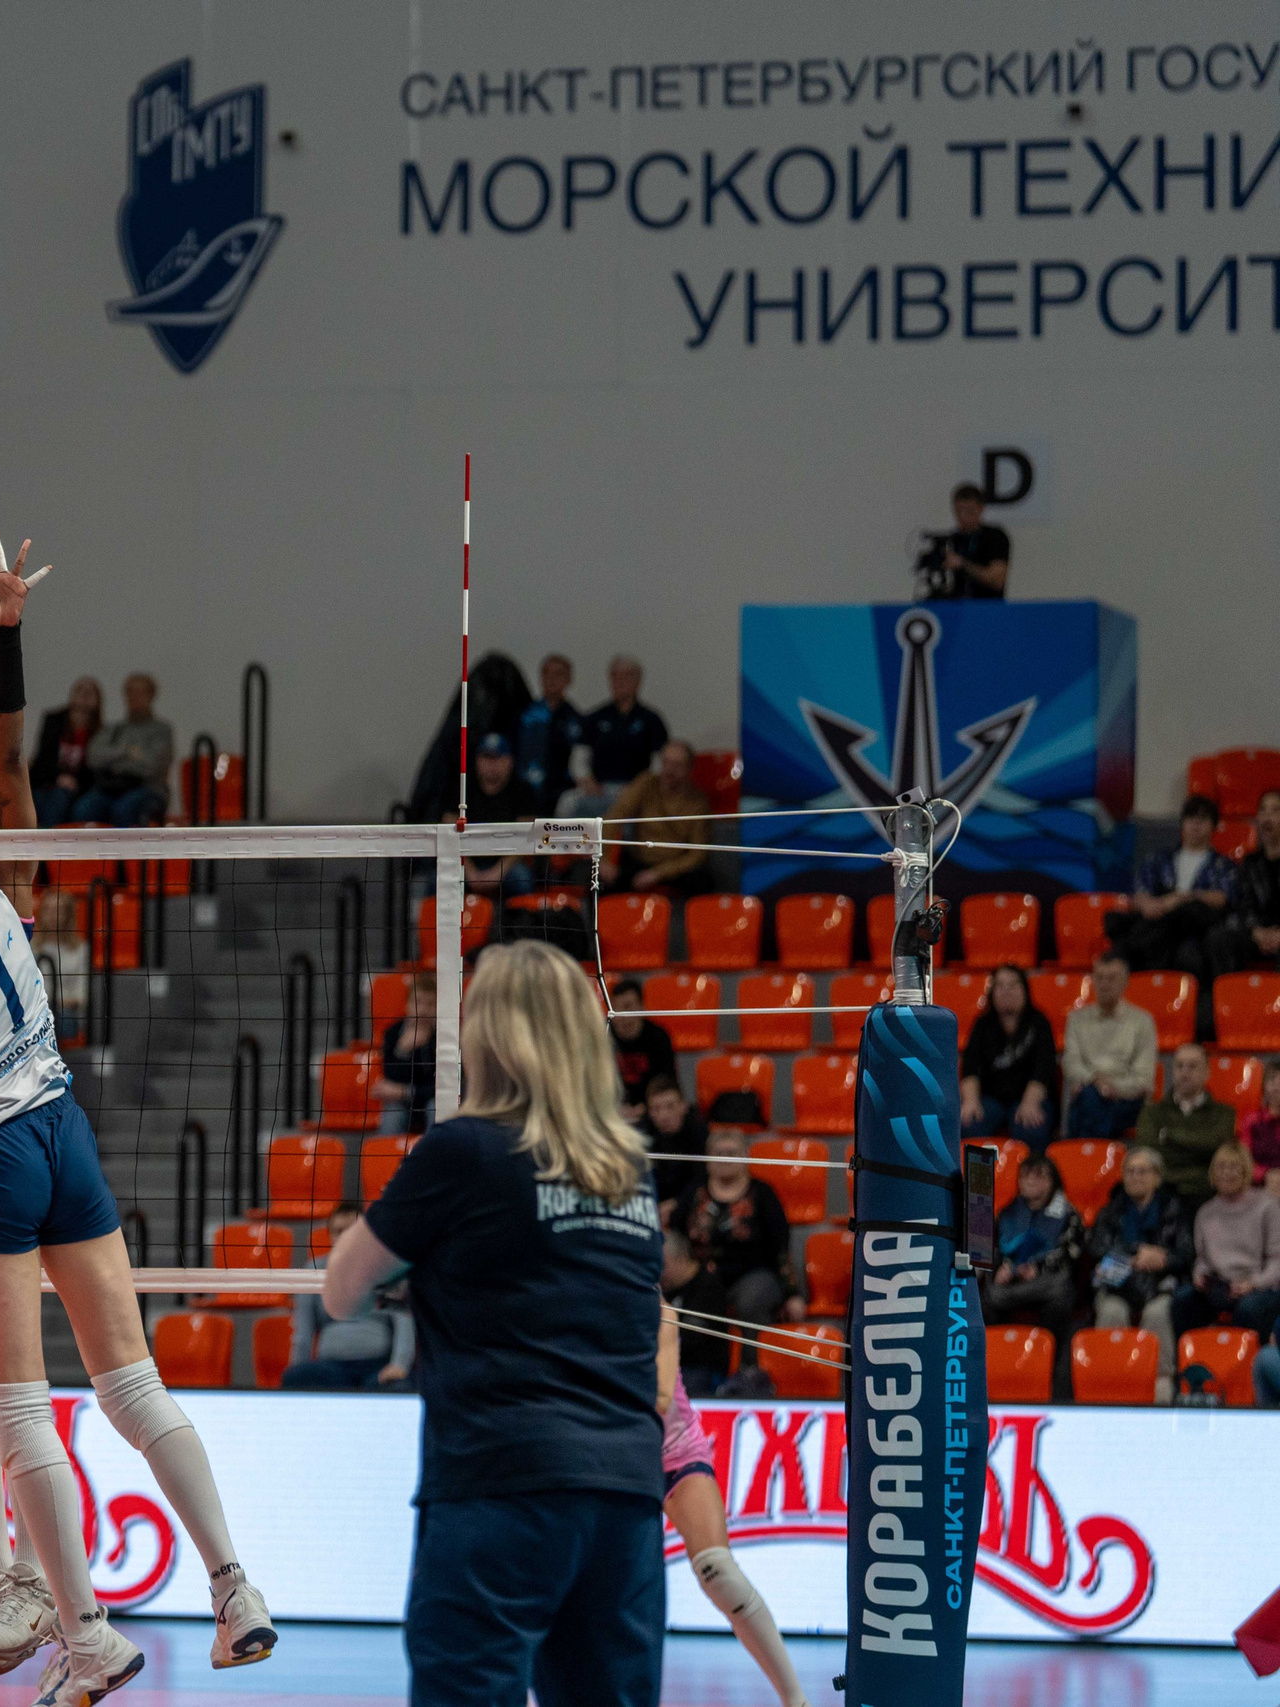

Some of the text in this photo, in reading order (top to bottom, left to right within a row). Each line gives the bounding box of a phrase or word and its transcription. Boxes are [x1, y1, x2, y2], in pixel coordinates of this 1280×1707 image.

[400, 38, 1280, 119] САНКТ-ПЕТЕРБУРГСКИЙ ГОСУ
[400, 124, 910, 237] МОРСКОЙ
[984, 450, 1033, 504] D
[552, 823, 584, 832] Senoh
[861, 1217, 939, 1657] КОРАБЕЛКА
